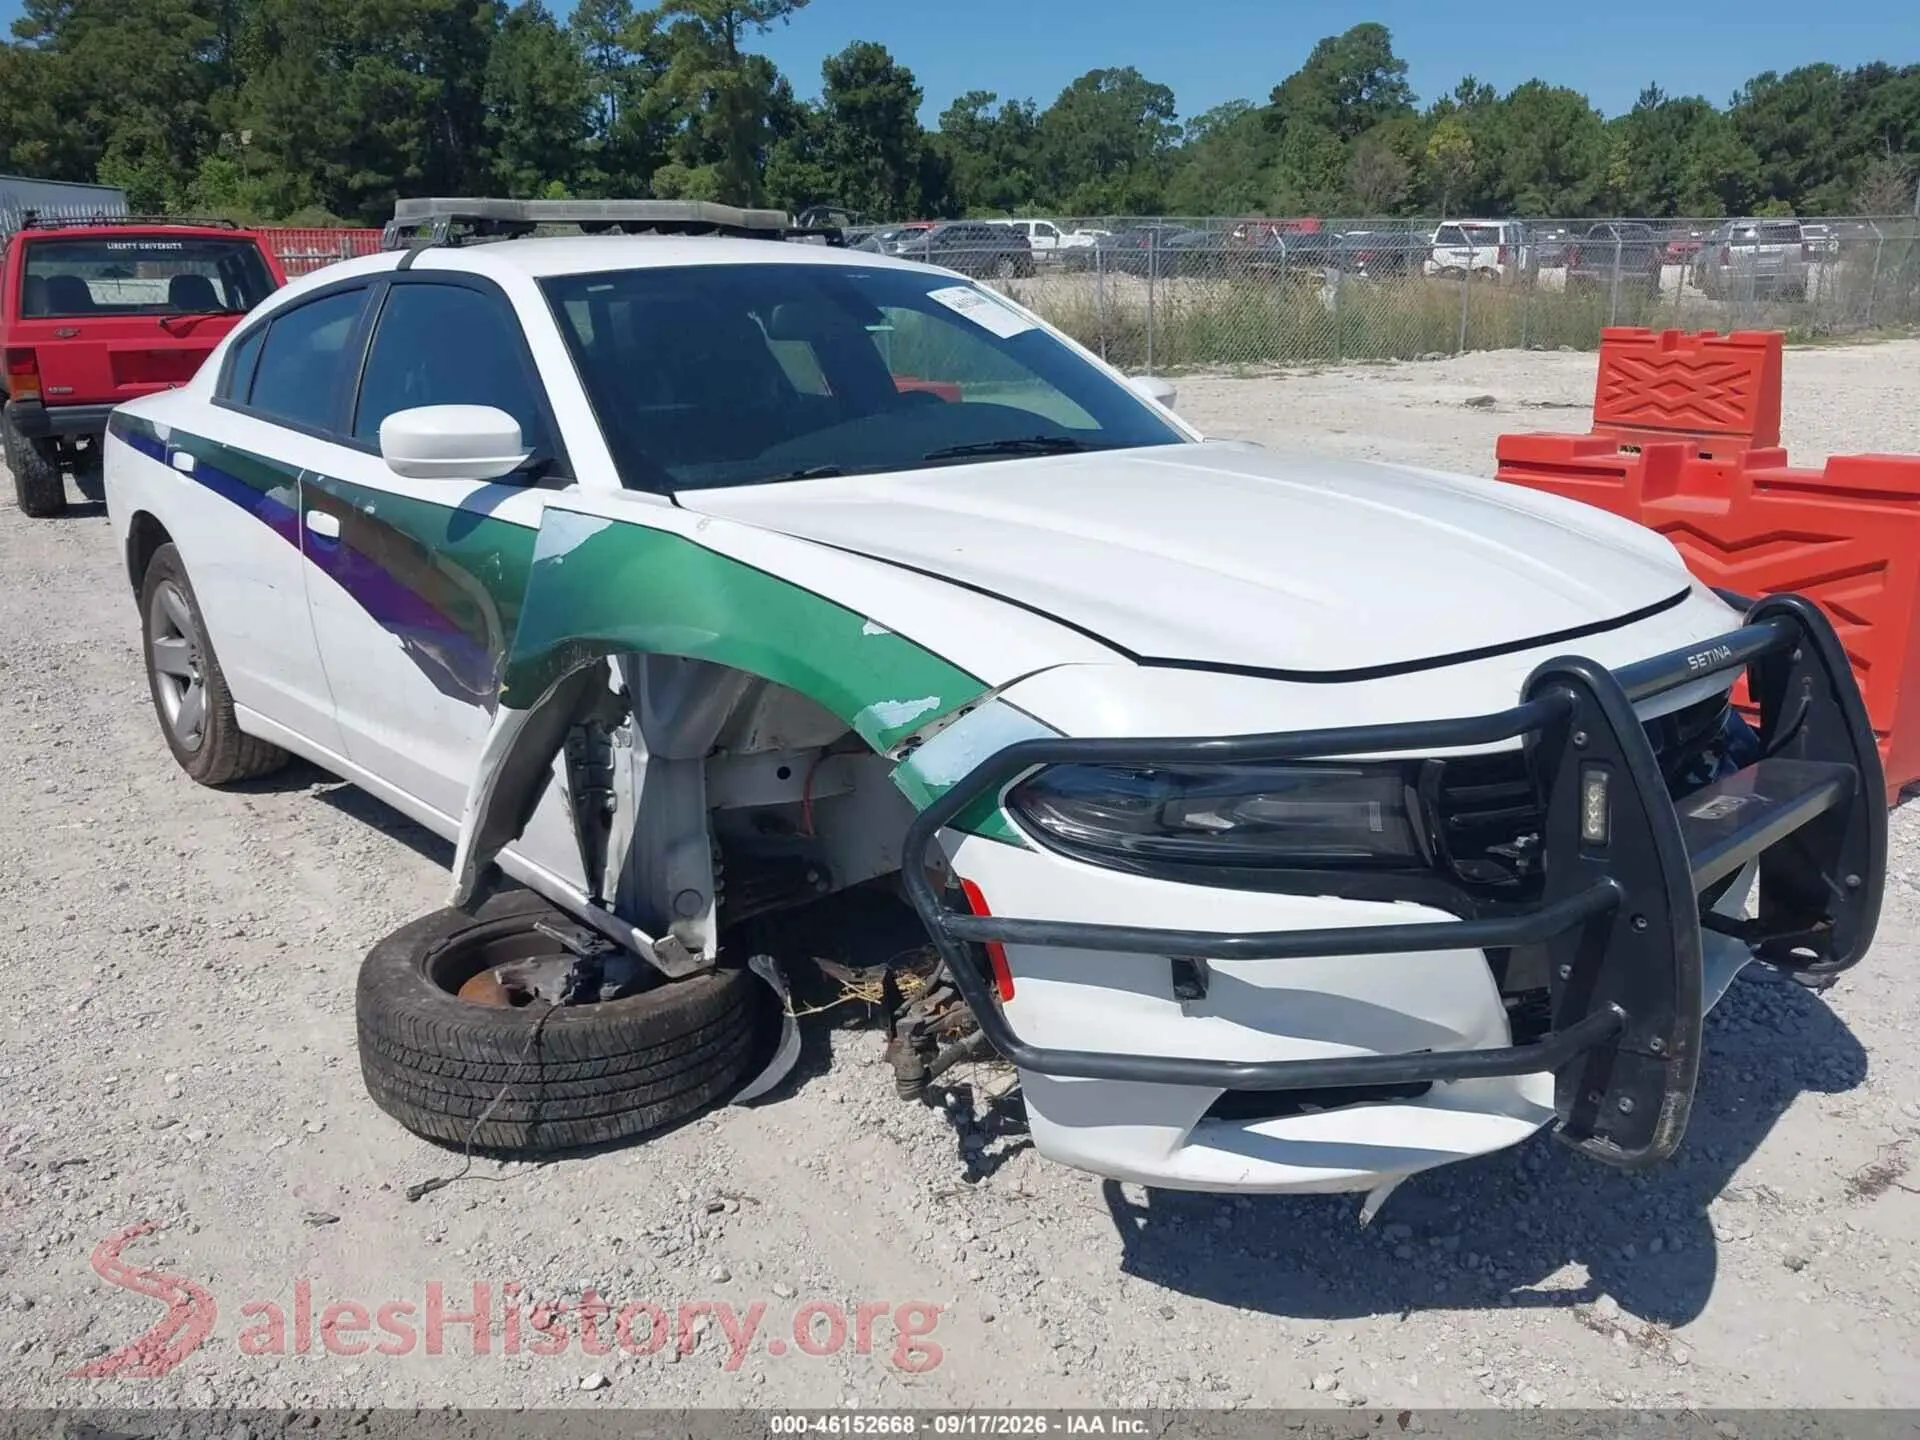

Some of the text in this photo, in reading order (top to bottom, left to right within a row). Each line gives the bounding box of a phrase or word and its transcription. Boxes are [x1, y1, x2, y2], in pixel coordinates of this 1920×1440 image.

[106, 242, 183, 250] LIBERTY UNIVERSITY
[1687, 644, 1732, 671] SETINA
